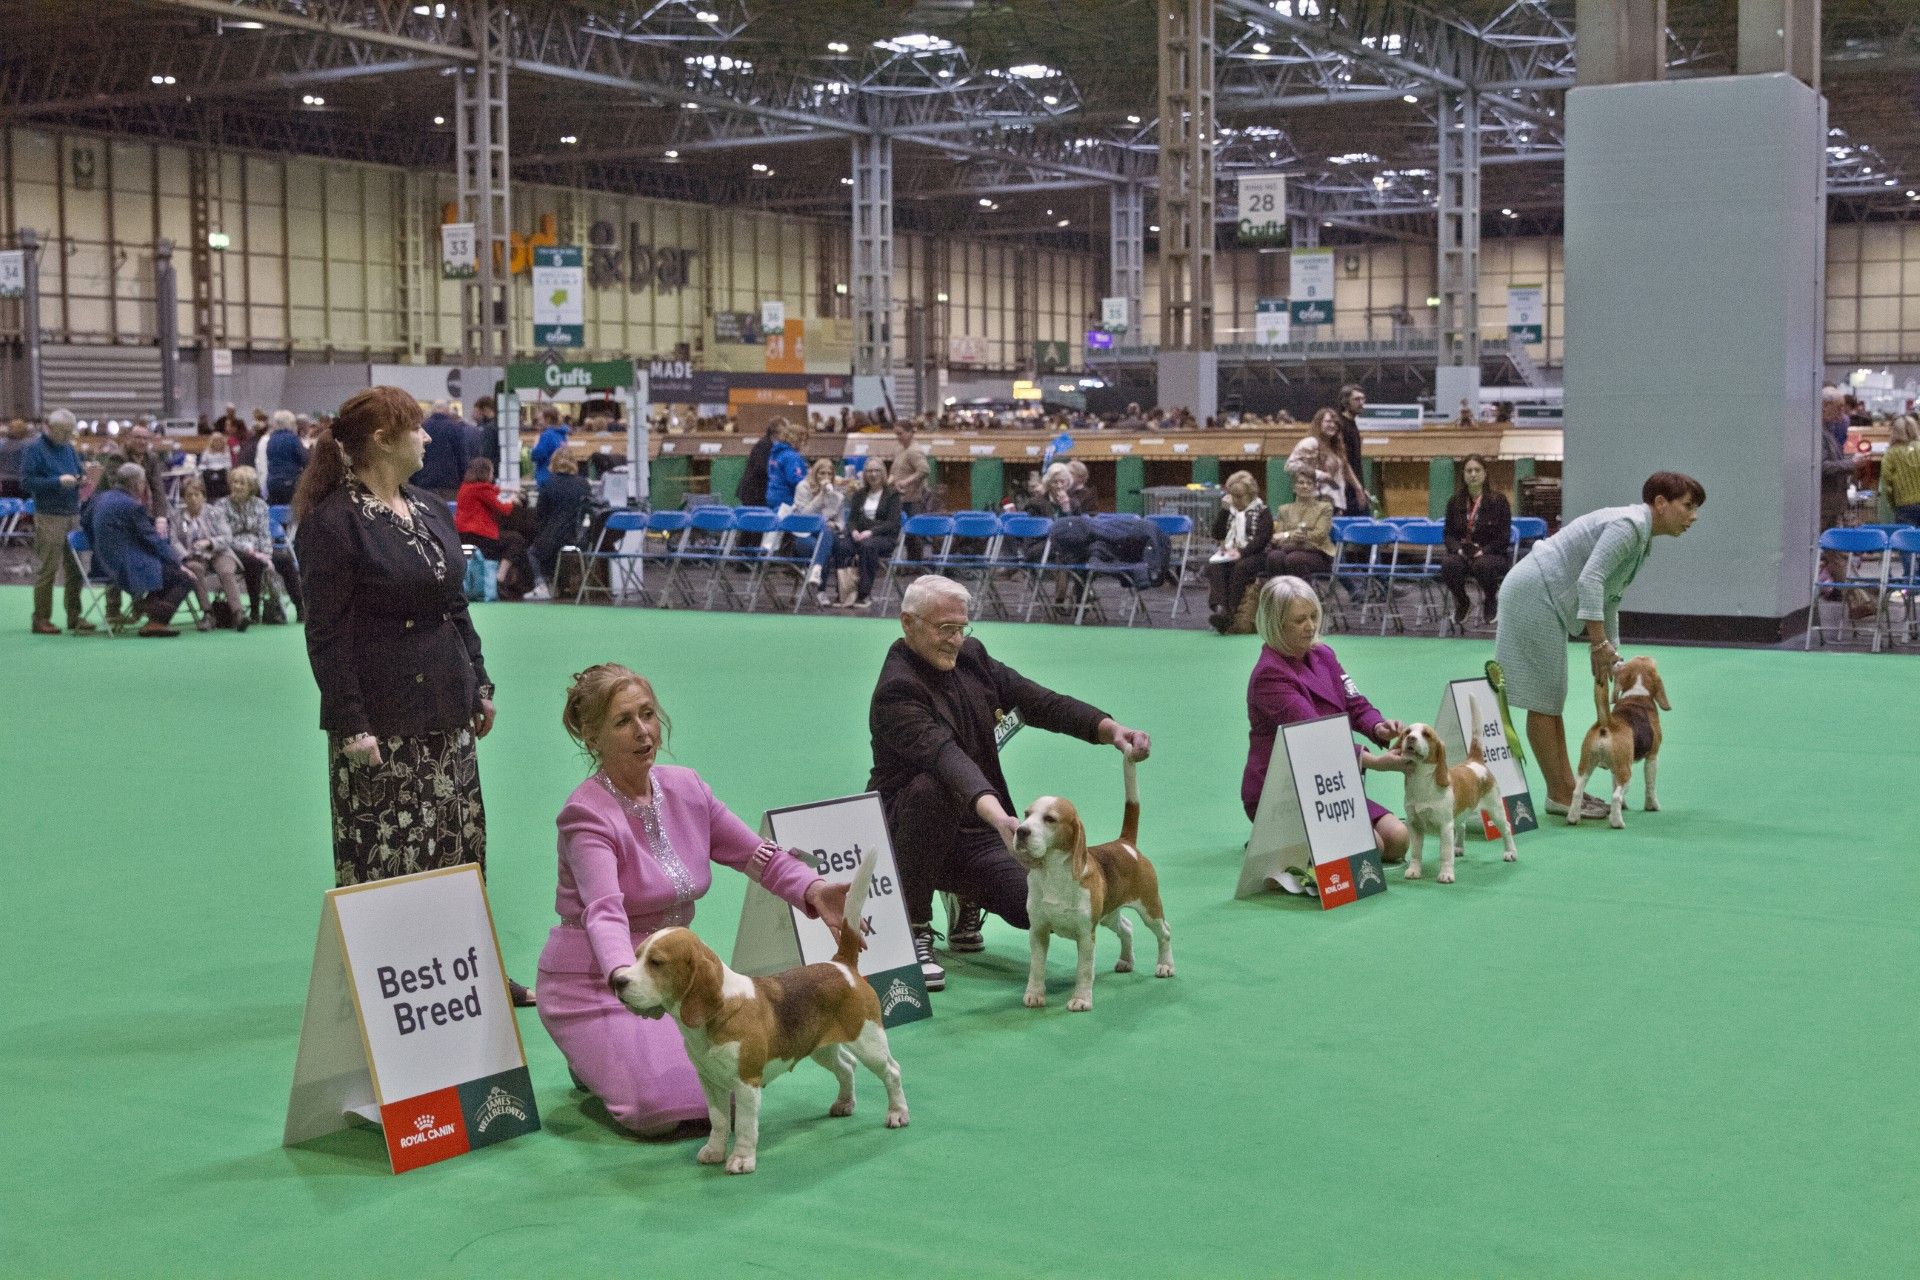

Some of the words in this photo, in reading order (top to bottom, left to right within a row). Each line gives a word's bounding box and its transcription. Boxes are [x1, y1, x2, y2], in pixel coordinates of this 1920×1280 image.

[1249, 194, 1275, 212] 28
[450, 240, 469, 255] 33
[629, 222, 699, 291] bar
[545, 364, 592, 387] Crufts
[650, 361, 693, 379] MADE
[1483, 719, 1501, 738] est
[1314, 770, 1346, 796] Best
[1314, 796, 1356, 823] Puppy
[812, 843, 862, 876] Best
[377, 957, 446, 1000] Best
[453, 946, 479, 981] of
[393, 985, 483, 1036] Breed
[486, 1096, 511, 1112] JAMES
[478, 1105, 527, 1132] WELLBELOVED
[400, 1132, 428, 1149] ROYAL
[427, 1122, 455, 1140] CANIN
